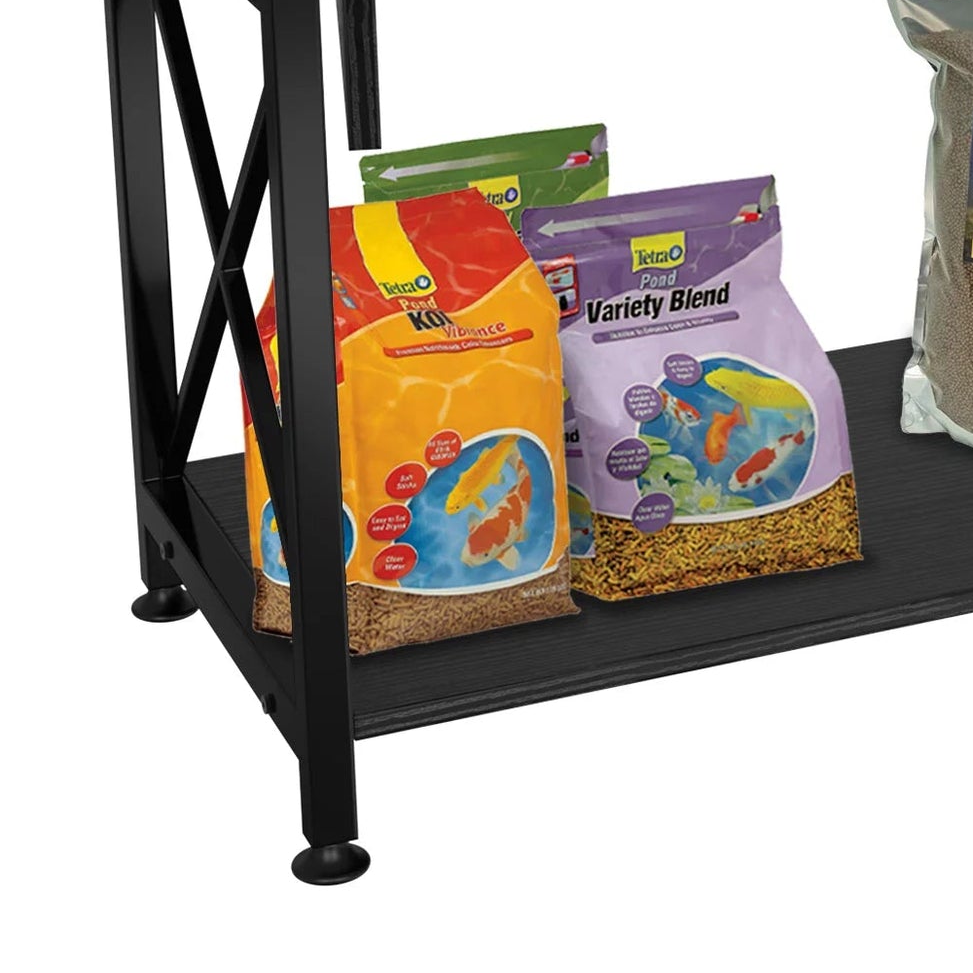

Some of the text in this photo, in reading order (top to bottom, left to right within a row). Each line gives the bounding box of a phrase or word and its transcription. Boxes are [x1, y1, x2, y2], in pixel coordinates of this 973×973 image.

[486, 192, 504, 205] tra
[635, 249, 669, 265] Tetra
[640, 270, 677, 289] Pond
[379, 281, 416, 295] Tetra
[399, 297, 437, 310] Pond
[586, 281, 731, 325] Variety Blend
